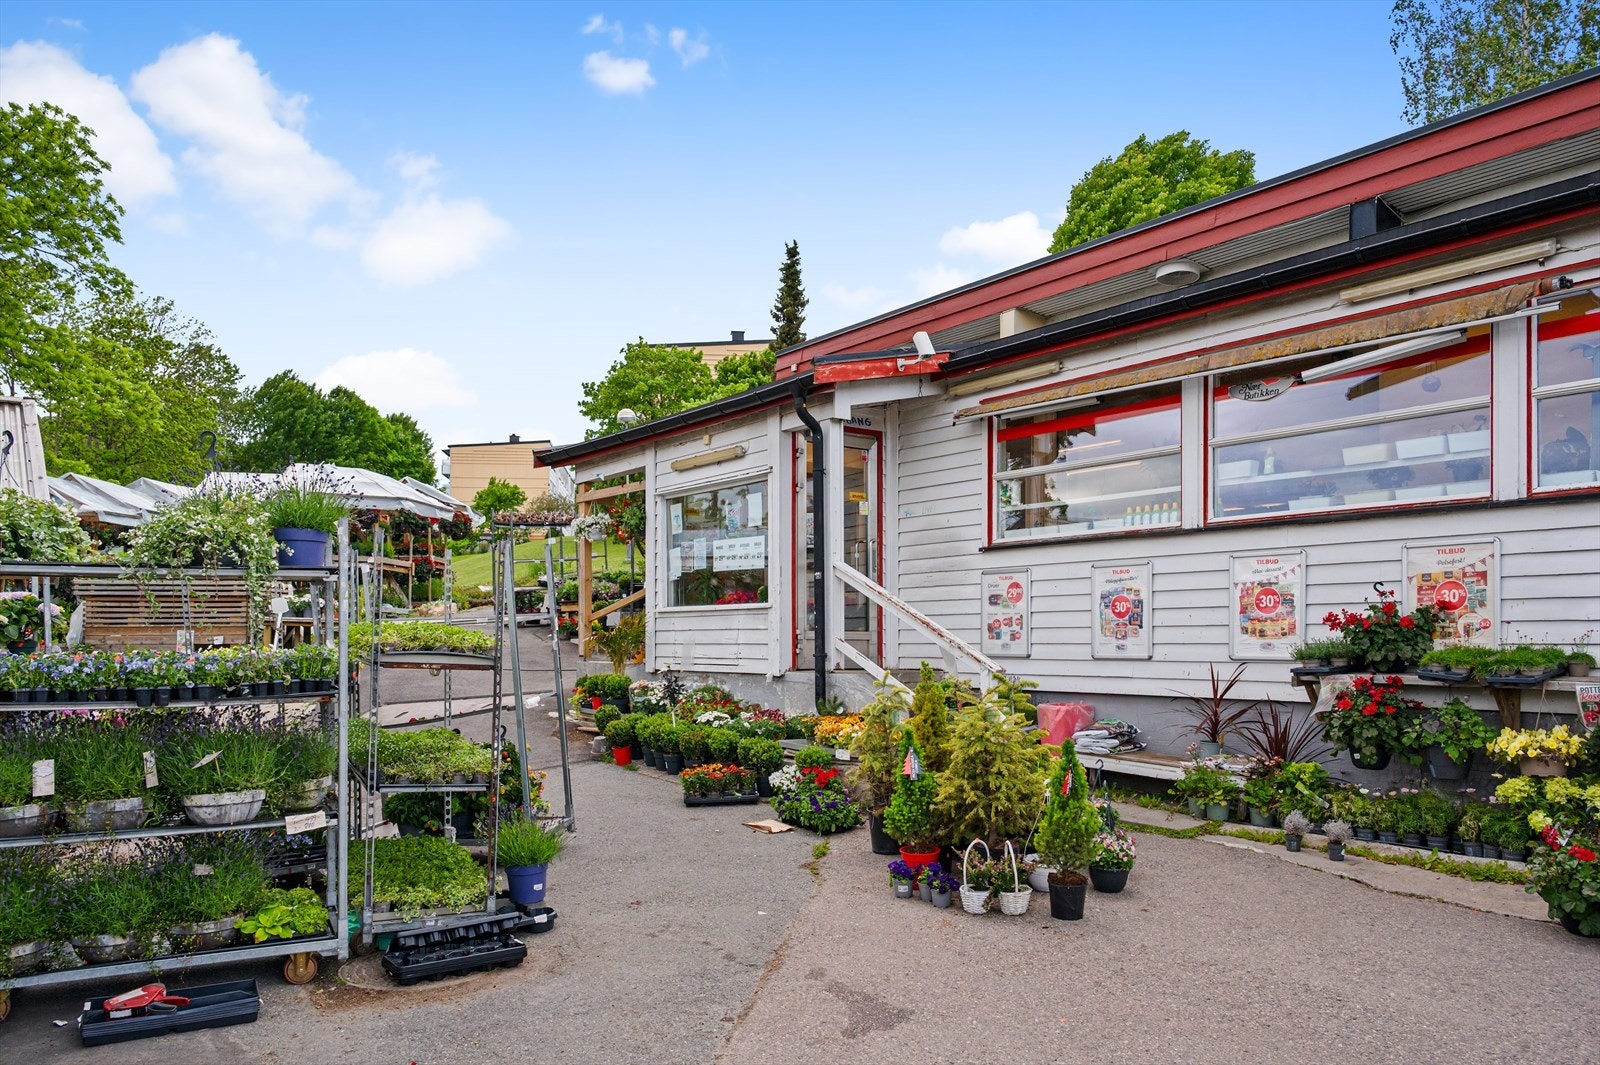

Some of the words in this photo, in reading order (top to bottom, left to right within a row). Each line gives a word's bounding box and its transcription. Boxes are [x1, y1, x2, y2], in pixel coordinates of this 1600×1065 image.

[1244, 389, 1280, 400] Butikken
[843, 417, 872, 426] GANG
[1436, 547, 1466, 555] TILBUD
[1436, 588, 1466, 603] -30%
[1112, 601, 1131, 613] -30%
[1256, 595, 1280, 608] -30%
